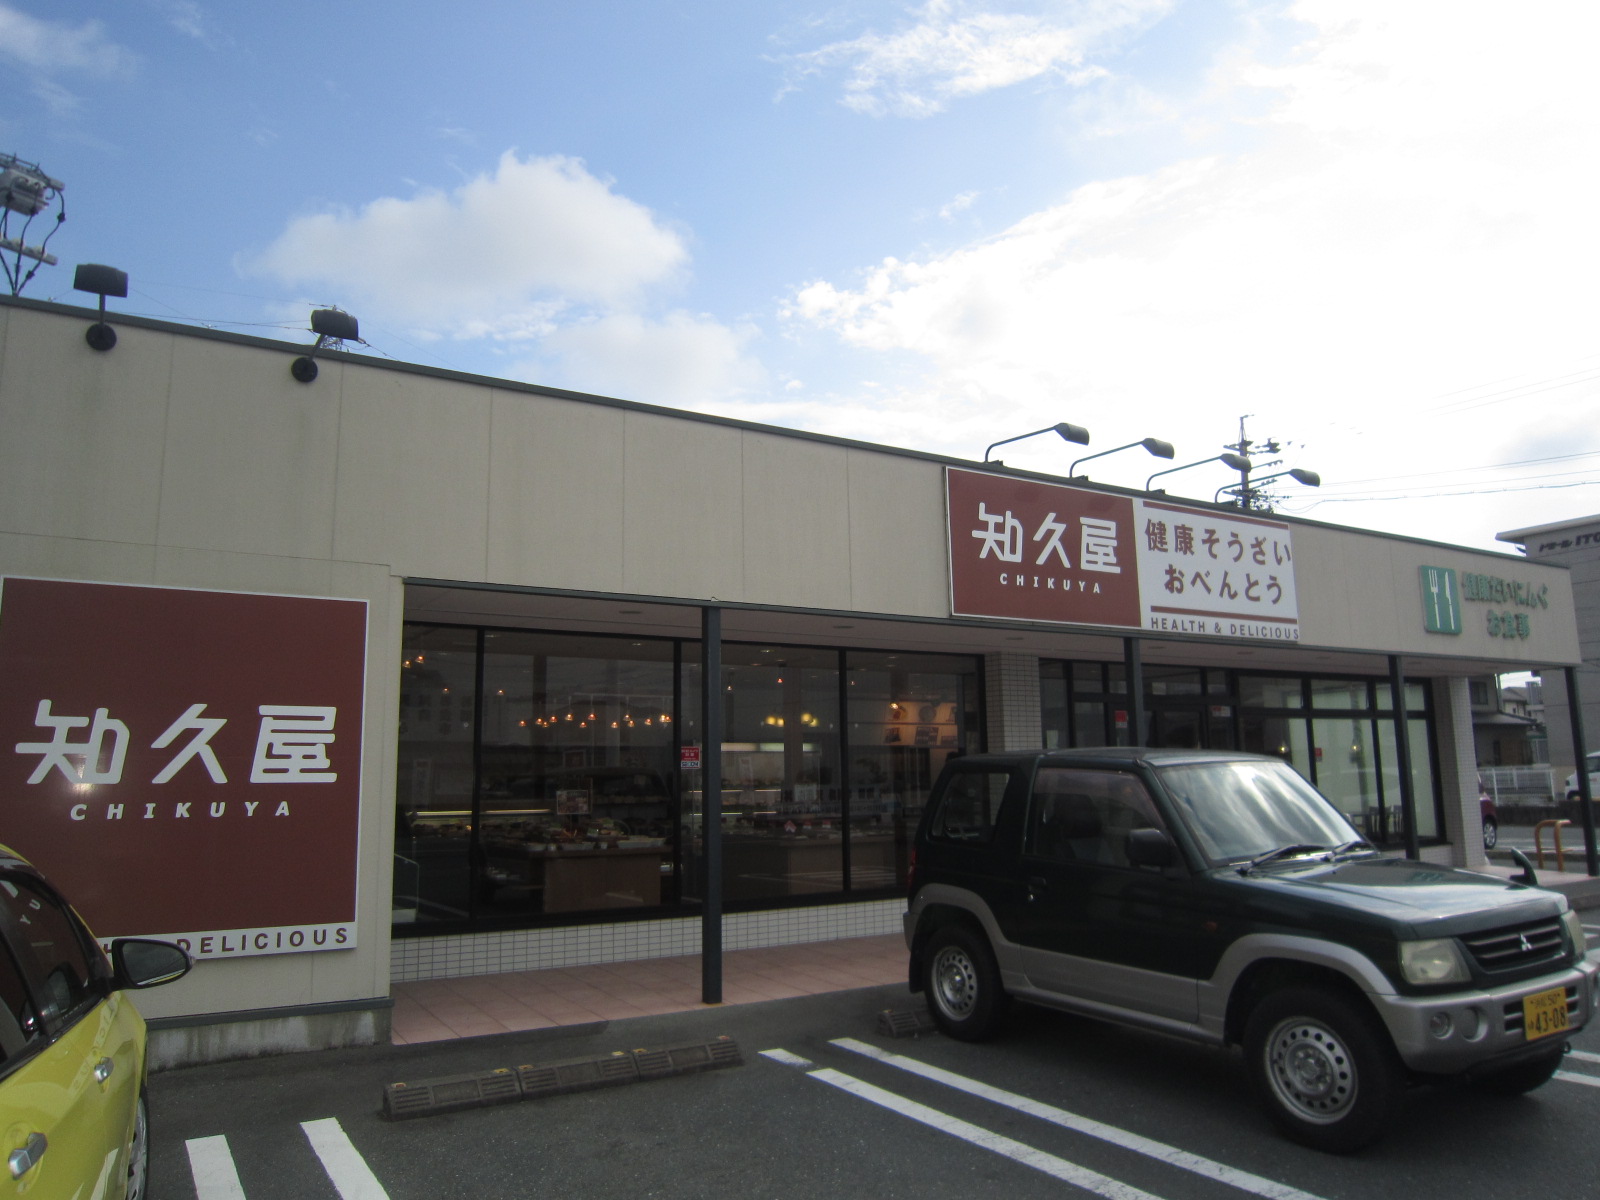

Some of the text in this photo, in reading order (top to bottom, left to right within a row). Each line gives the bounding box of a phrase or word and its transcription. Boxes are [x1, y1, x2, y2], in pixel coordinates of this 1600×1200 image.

[971, 502, 1121, 574] 知久屋
[1144, 518, 1292, 567] 健康そうざい
[999, 572, 1101, 594] CHIKUYA
[1164, 563, 1283, 606] おべんとう
[1150, 616, 1300, 640] HEALTH & DELICIOUS
[15, 698, 338, 786] 知久屋
[70, 800, 290, 821] CHIKUYA
[176, 927, 348, 955] DELICIOUS
[1535, 1006, 1565, 1033] 43-08
